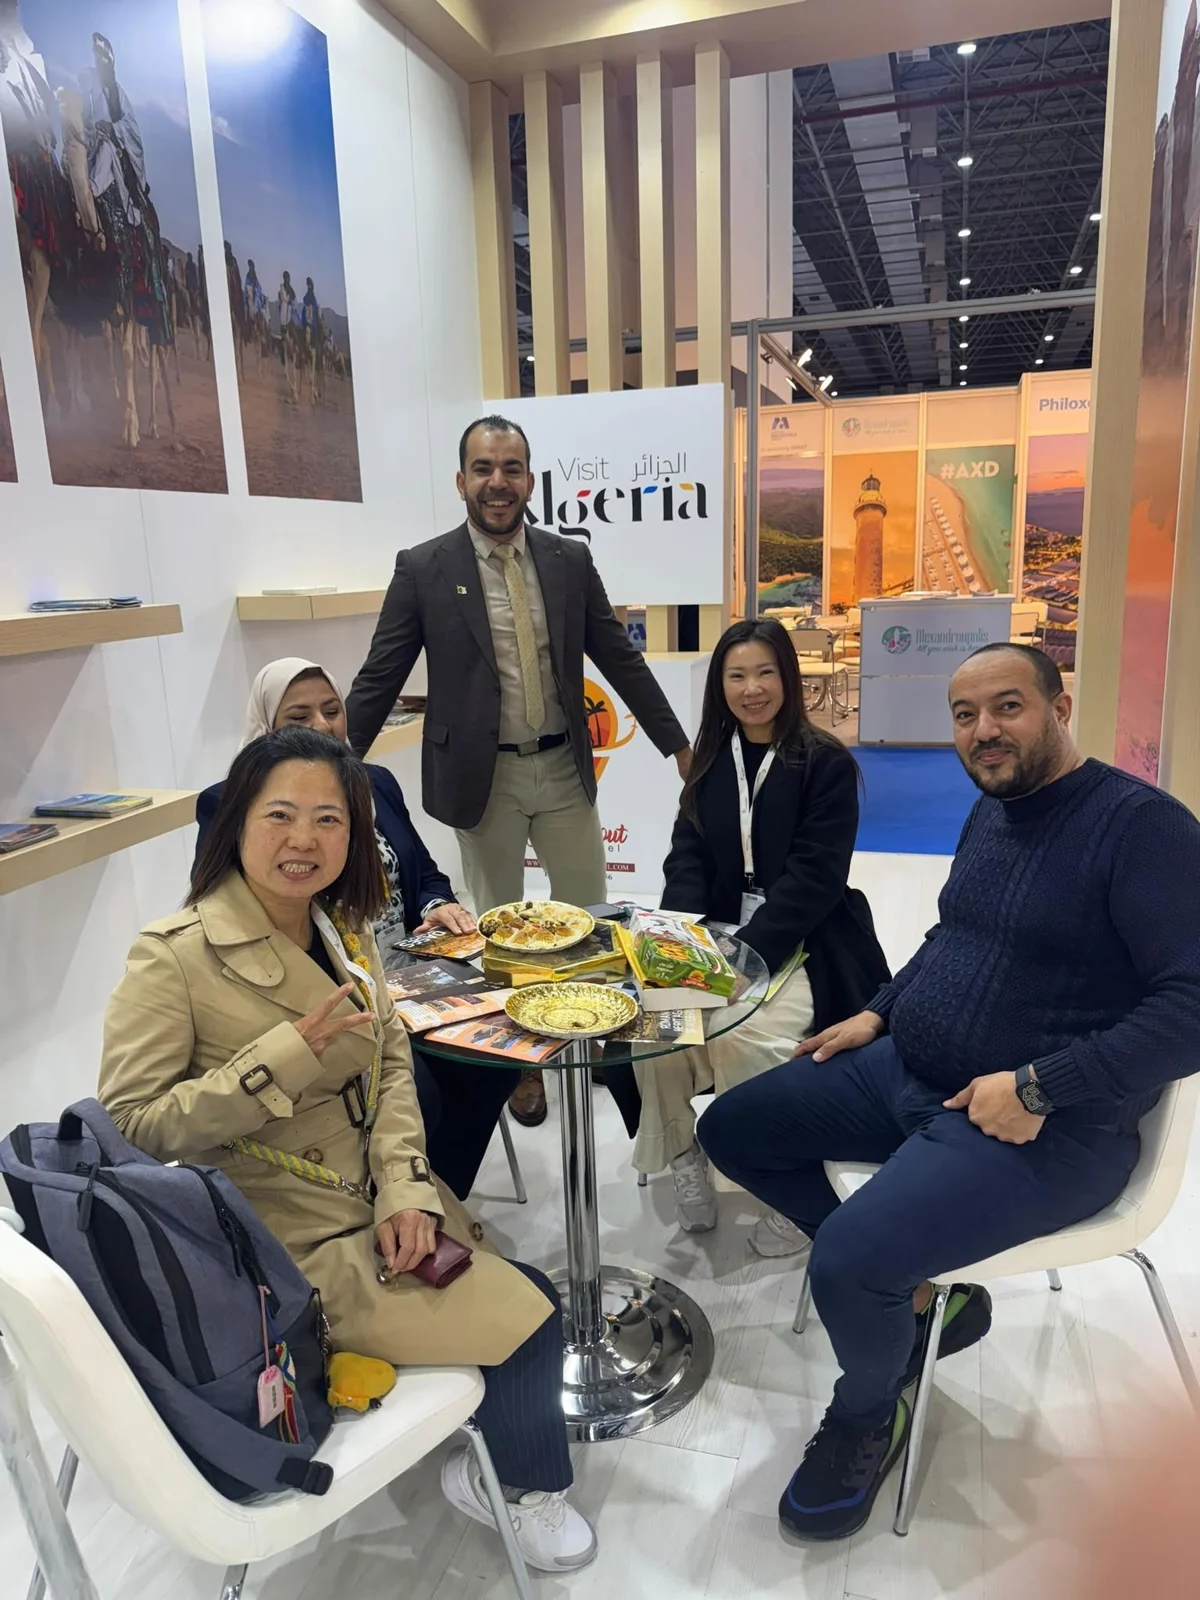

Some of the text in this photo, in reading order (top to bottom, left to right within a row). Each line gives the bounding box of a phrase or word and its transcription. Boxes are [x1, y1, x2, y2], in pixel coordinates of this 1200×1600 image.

[1039, 397, 1090, 411] Philox
[557, 456, 610, 482] Visit
[632, 452, 687, 482] الجزائر
[940, 460, 1000, 480] #AXD
[601, 823, 629, 844] out
[607, 863, 629, 871] L.COM
